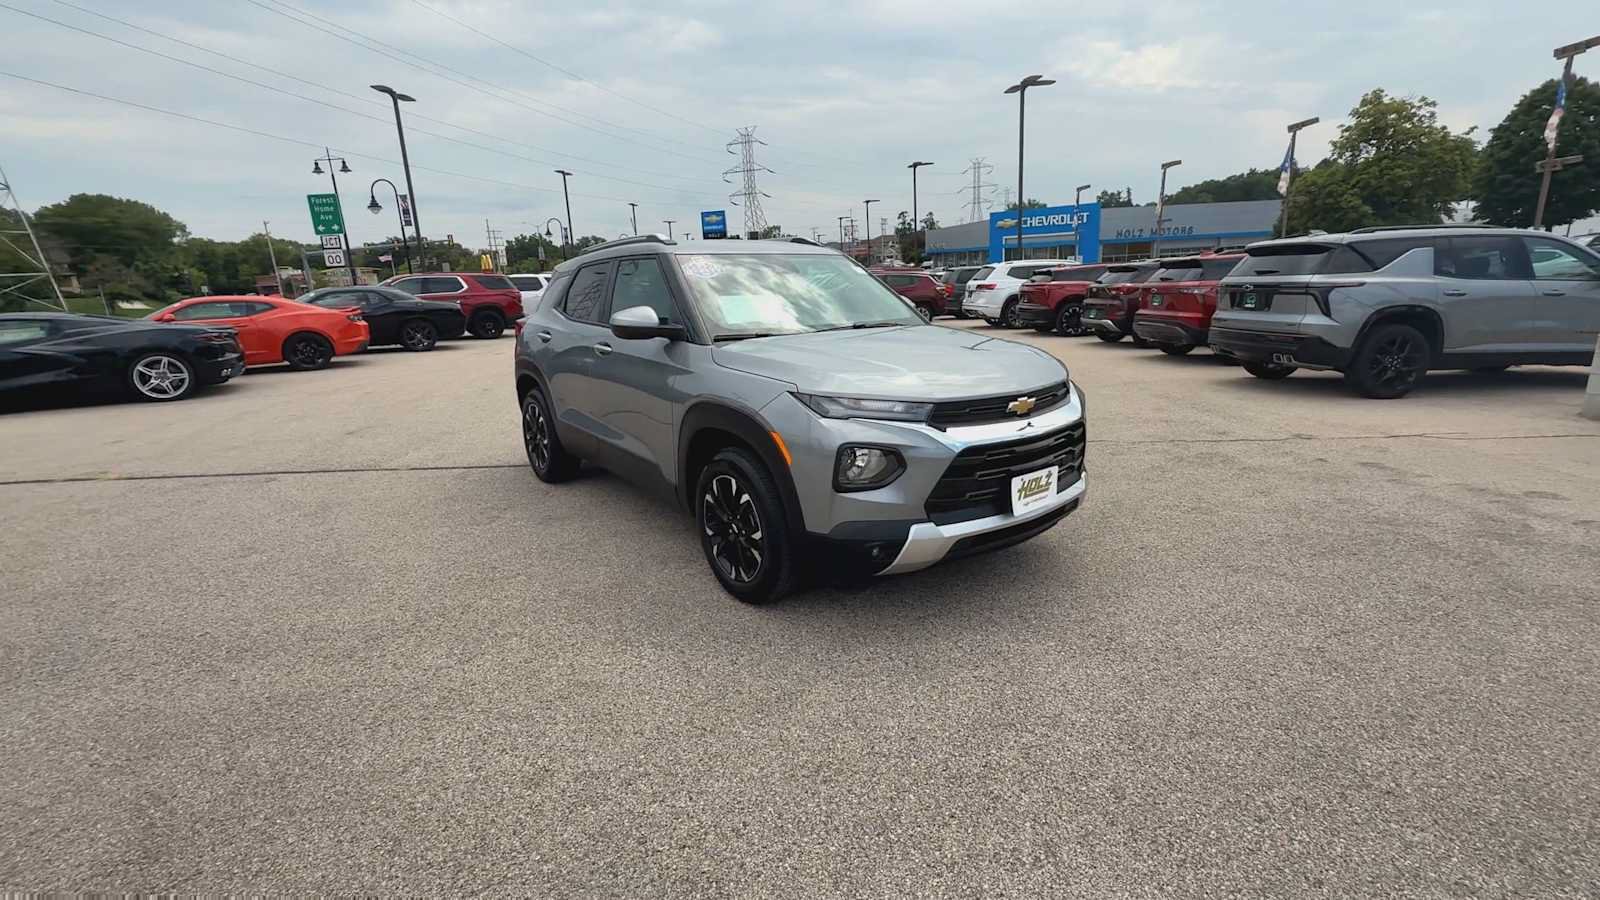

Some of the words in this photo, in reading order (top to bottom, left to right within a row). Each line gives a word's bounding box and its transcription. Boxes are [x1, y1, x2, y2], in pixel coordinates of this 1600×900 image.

[310, 196, 335, 204] Forest
[314, 205, 334, 213] Home
[1115, 228, 1143, 238] HOLZ
[1151, 226, 1194, 236] MOTORS
[323, 237, 339, 247] JCT
[1017, 470, 1052, 501] HOLZ
